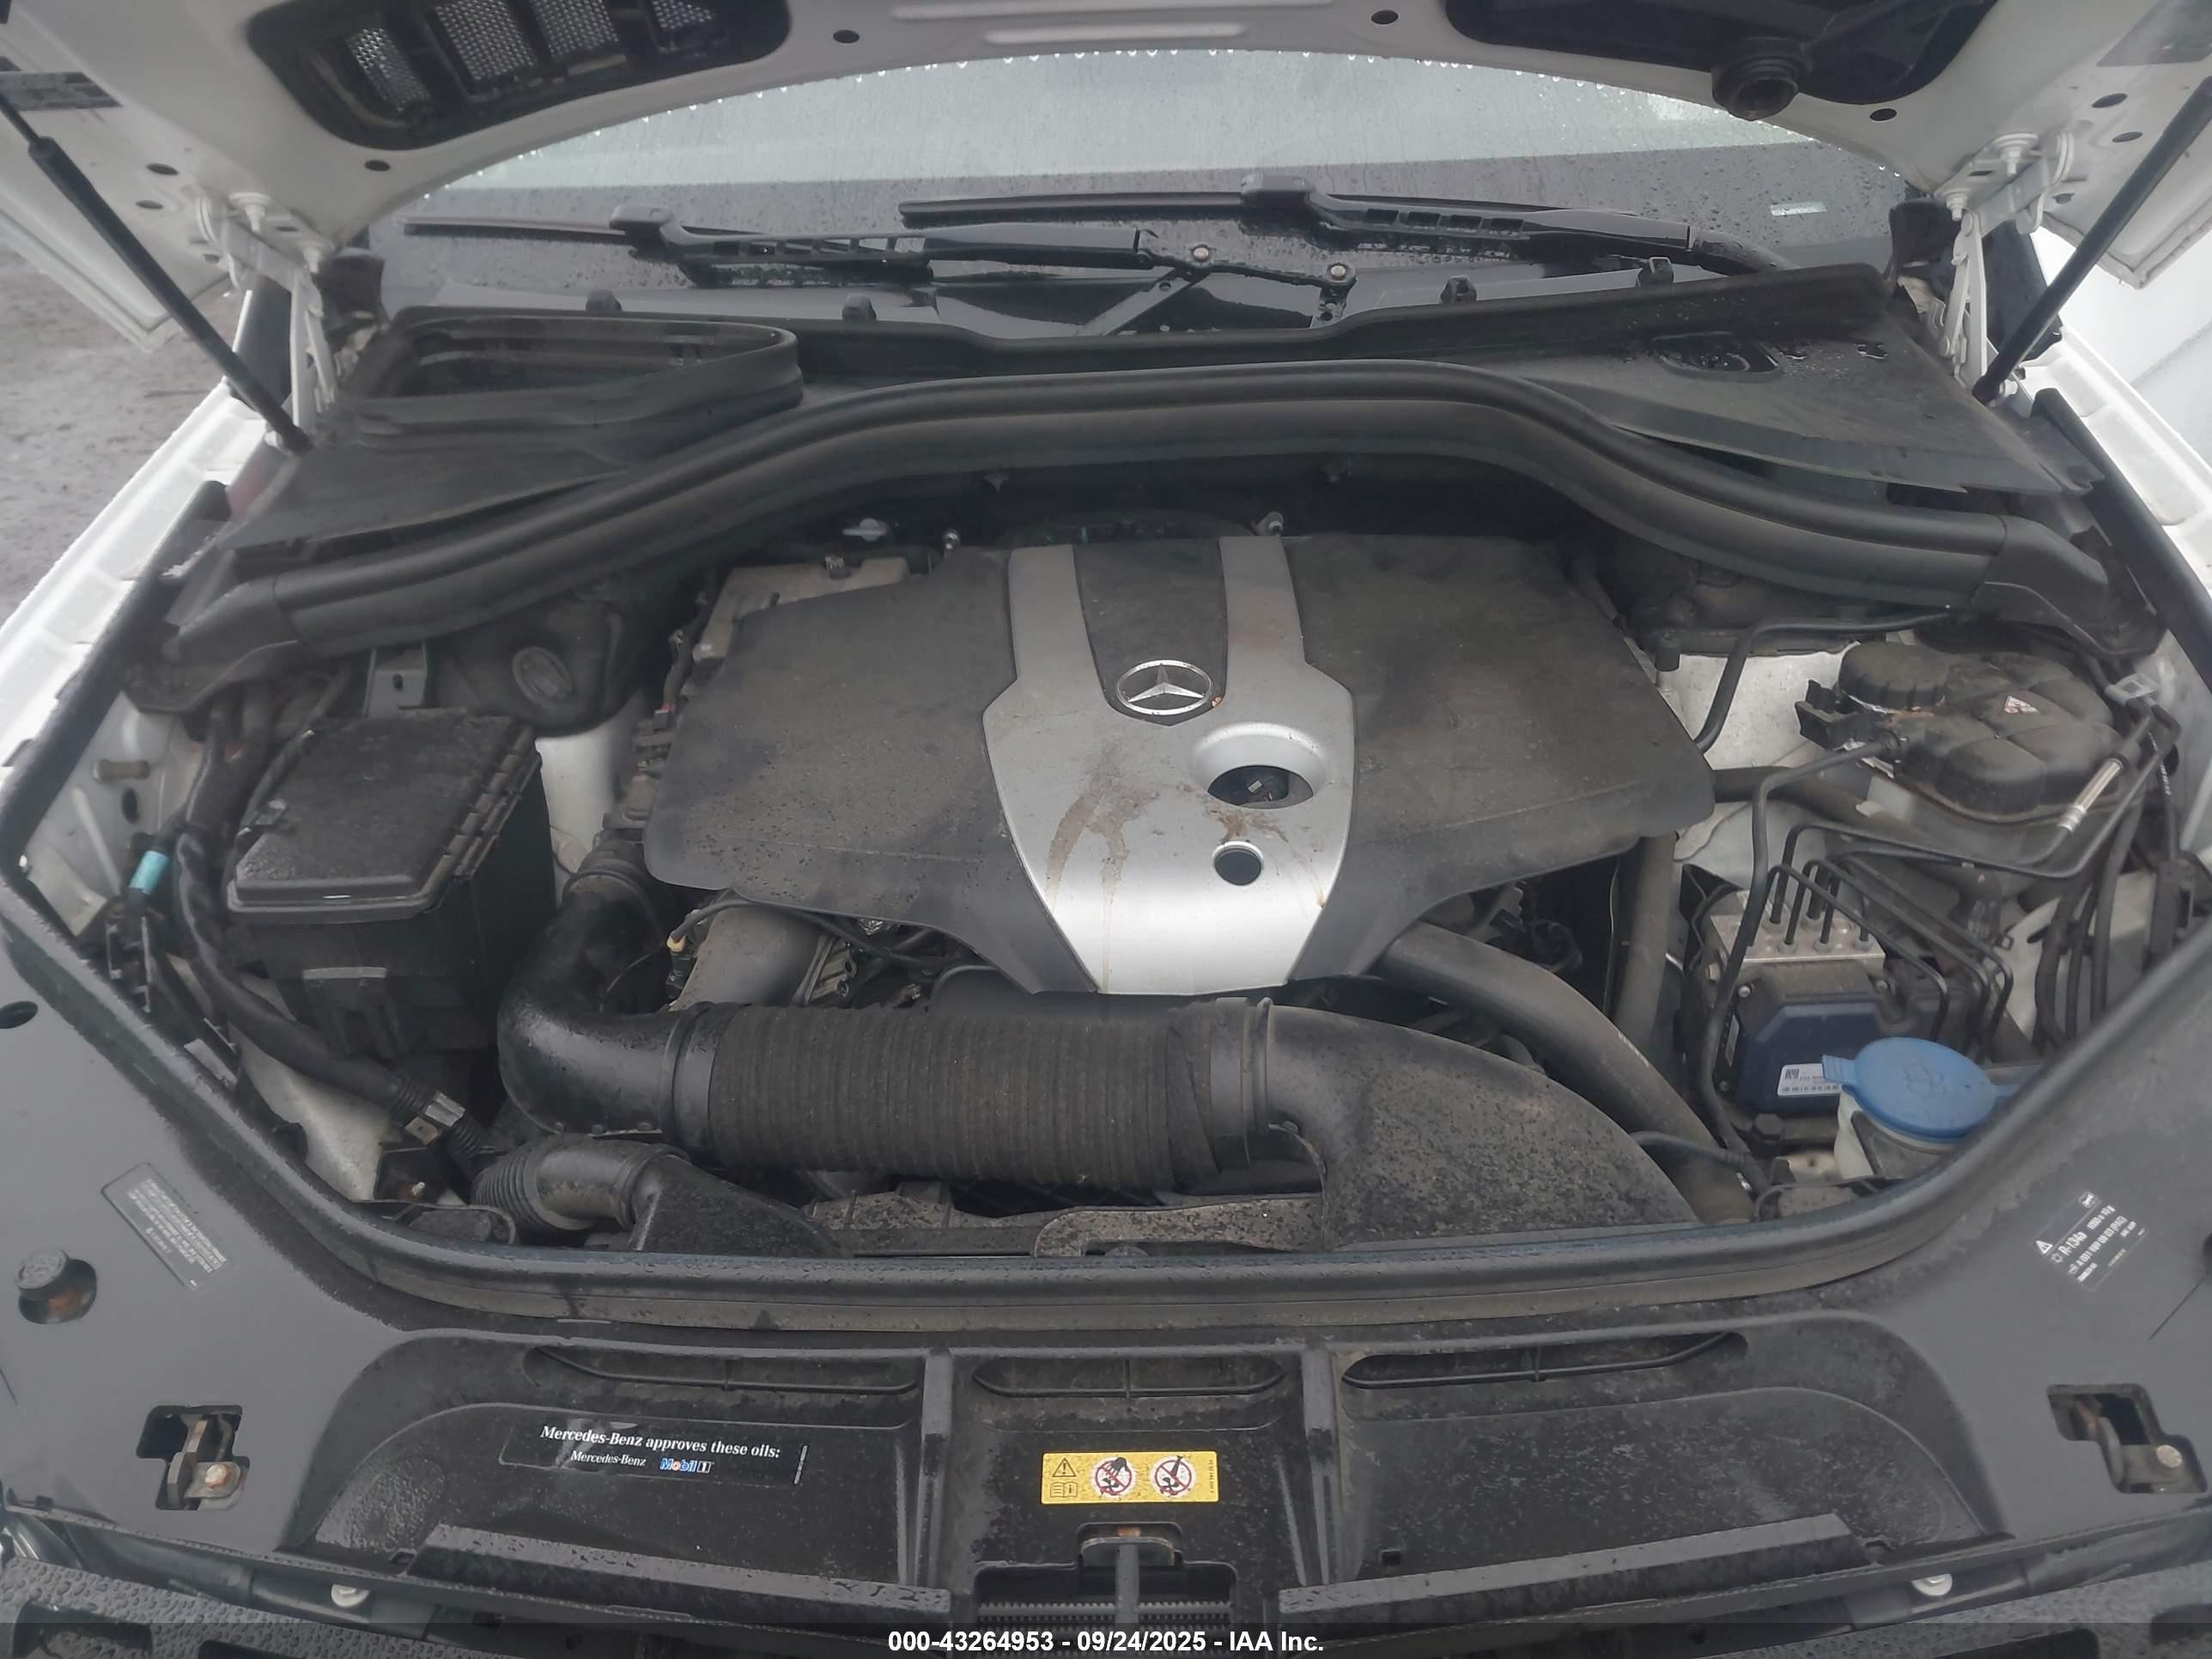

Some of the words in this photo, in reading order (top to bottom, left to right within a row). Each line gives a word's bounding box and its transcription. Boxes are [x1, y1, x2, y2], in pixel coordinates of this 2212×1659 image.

[539, 1425, 643, 1448] Mercedes-Benz
[645, 1436, 708, 1453] approves
[710, 1439, 748, 1456] these
[750, 1444, 781, 1459] oils:
[570, 1449, 647, 1467] Mercedes-Benz
[659, 1458, 697, 1473] Mobil
